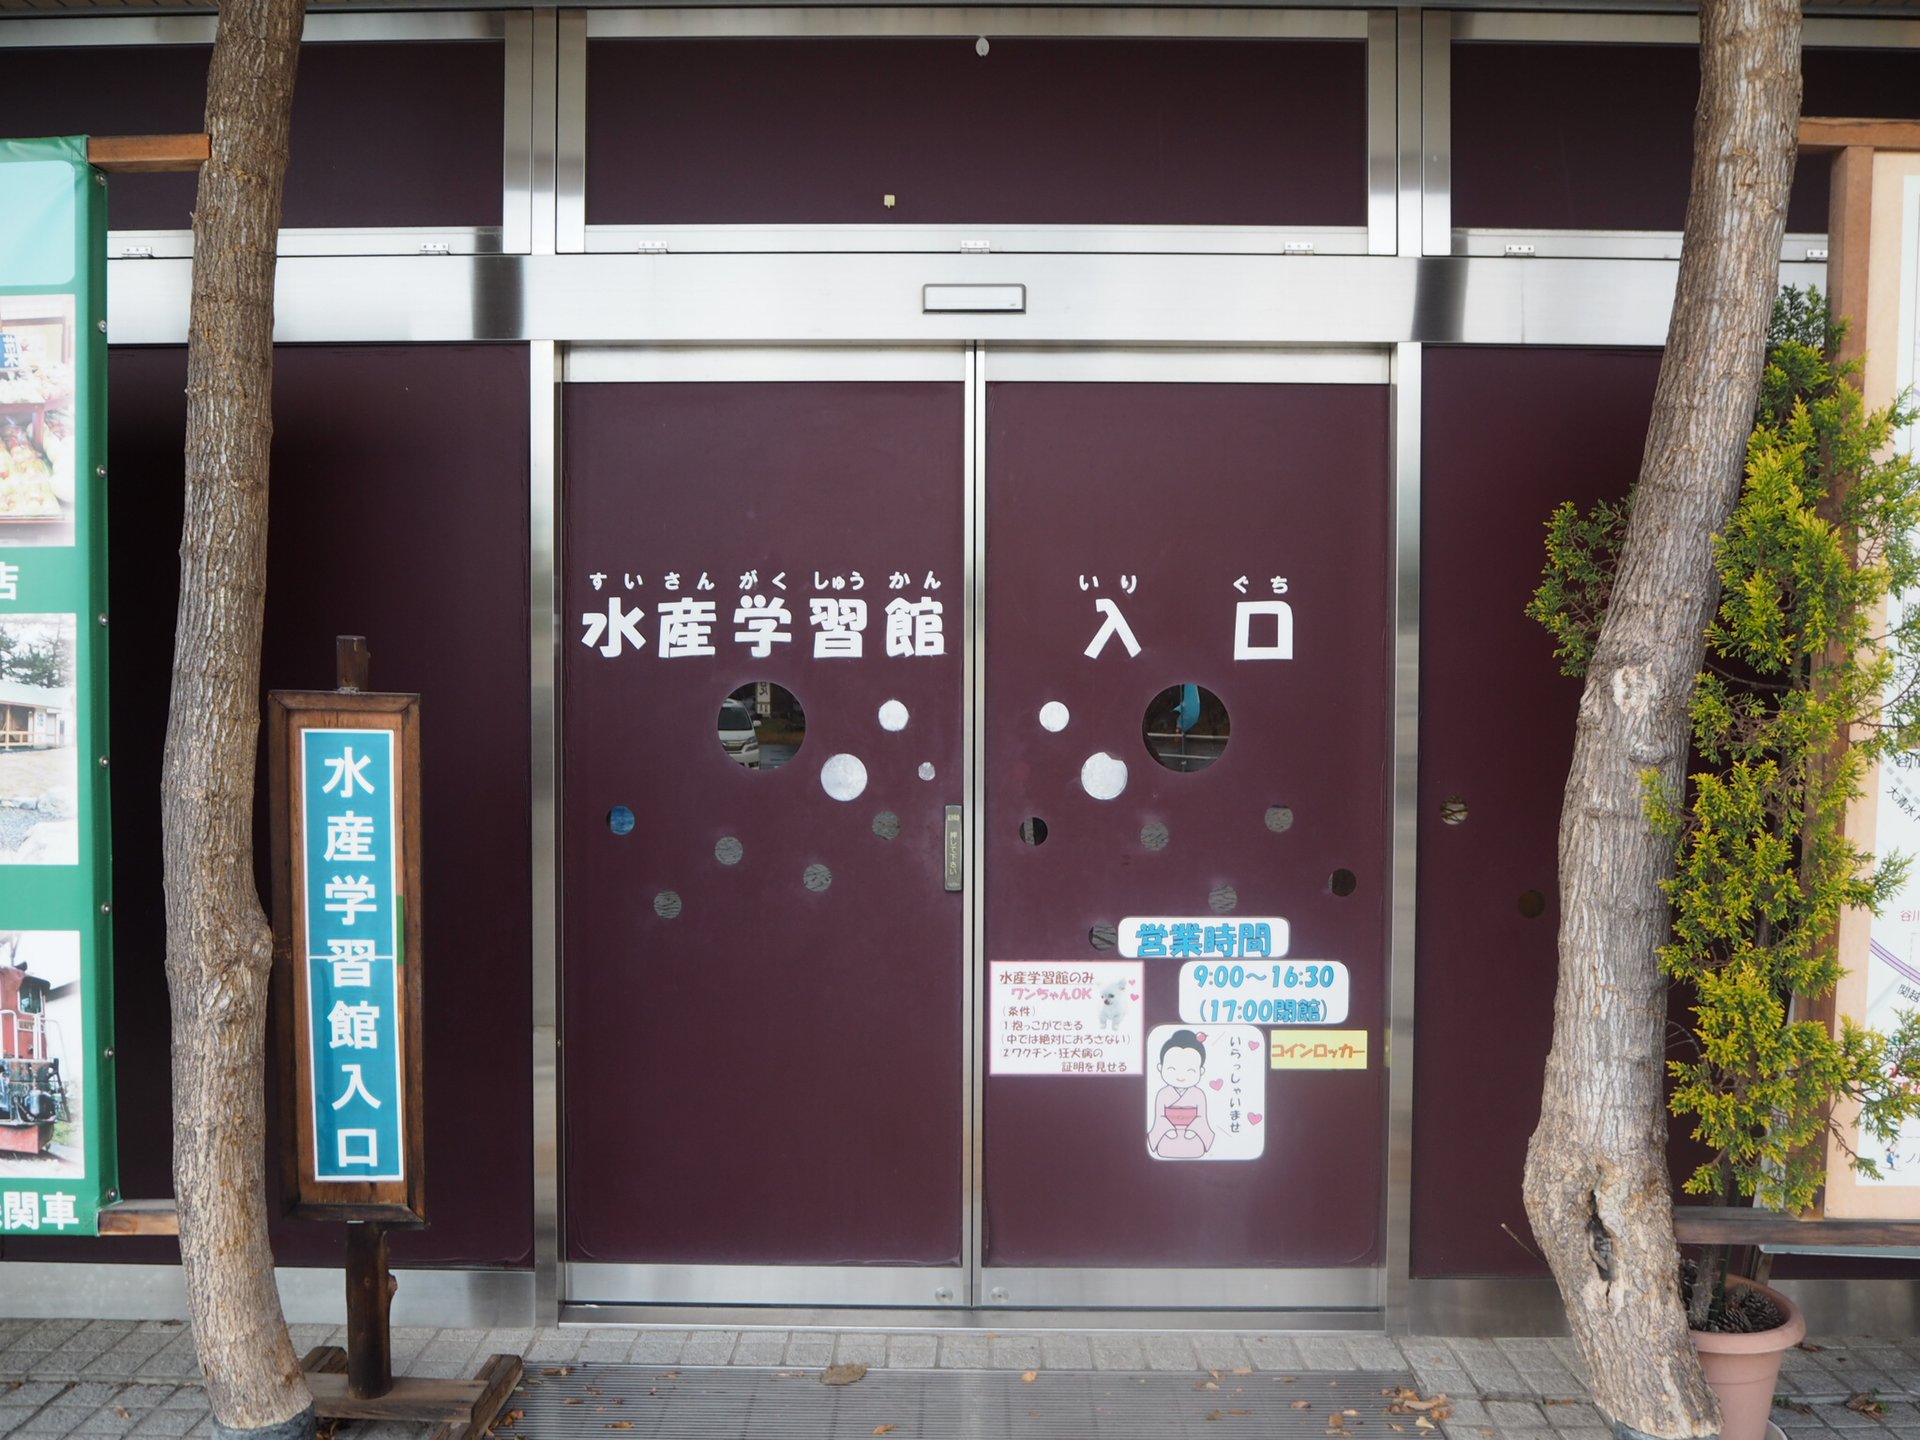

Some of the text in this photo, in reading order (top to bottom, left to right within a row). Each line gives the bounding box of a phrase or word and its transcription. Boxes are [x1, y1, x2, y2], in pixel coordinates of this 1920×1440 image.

[589, 571, 942, 591] すいさんがくしゅうかん
[1078, 574, 1289, 594] いりぐち
[581, 596, 945, 659] 水産学習館
[1083, 598, 1294, 660] 入口
[1135, 923, 1272, 958] 営業時間
[321, 746, 382, 1168] 水産学習館入口
[1000, 971, 1095, 985] 水産学習館のみ
[1193, 965, 1334, 988] 9:00～16:30
[1011, 987, 1093, 1001] ワンちゃんOK
[1200, 999, 1327, 1023] (17:00閉館)
[1271, 1043, 1366, 1059] コインロッカー
[1061, 1061, 1128, 1073] 証明を見せる
[1229, 1035, 1242, 1134] いらっしゃいませ
